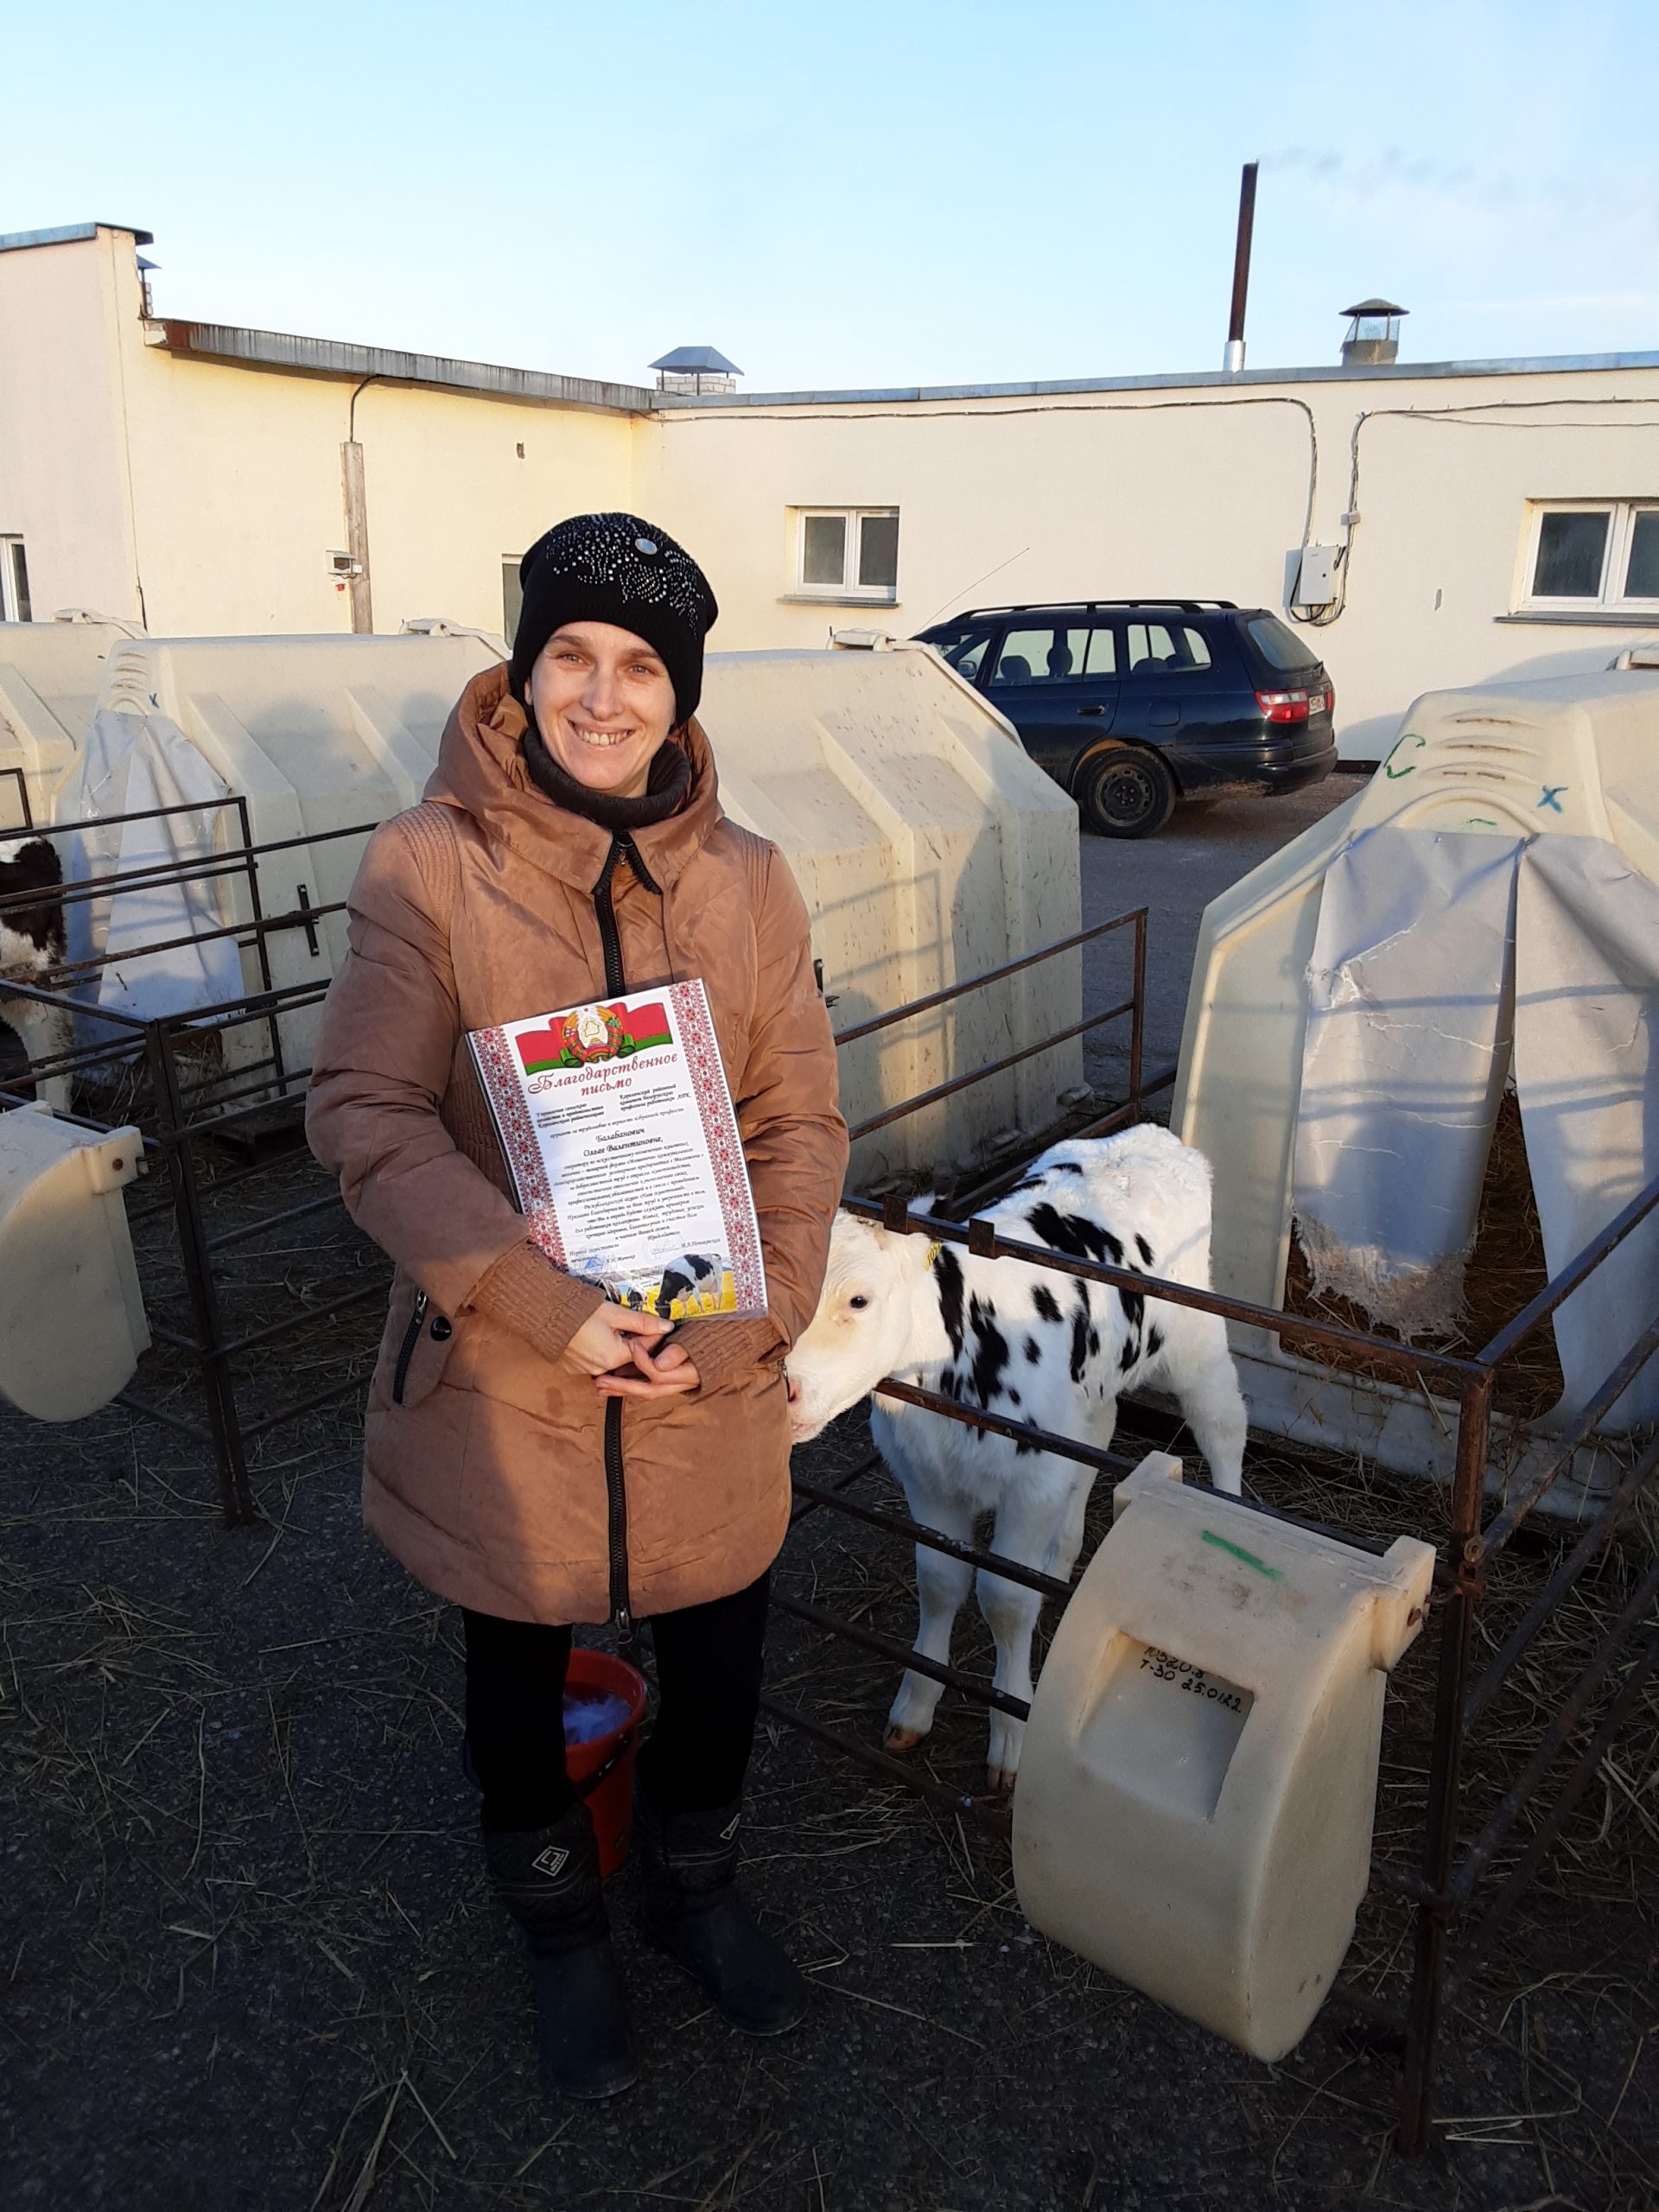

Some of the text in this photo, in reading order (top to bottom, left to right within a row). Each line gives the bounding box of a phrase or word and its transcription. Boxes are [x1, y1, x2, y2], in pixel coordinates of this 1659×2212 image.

[528, 1053, 678, 1095] Благодарственное
[581, 1077, 632, 1096] письмо
[595, 1128, 645, 1142] Балабанович
[583, 1137, 663, 1157] Ольге Валентиновне,
